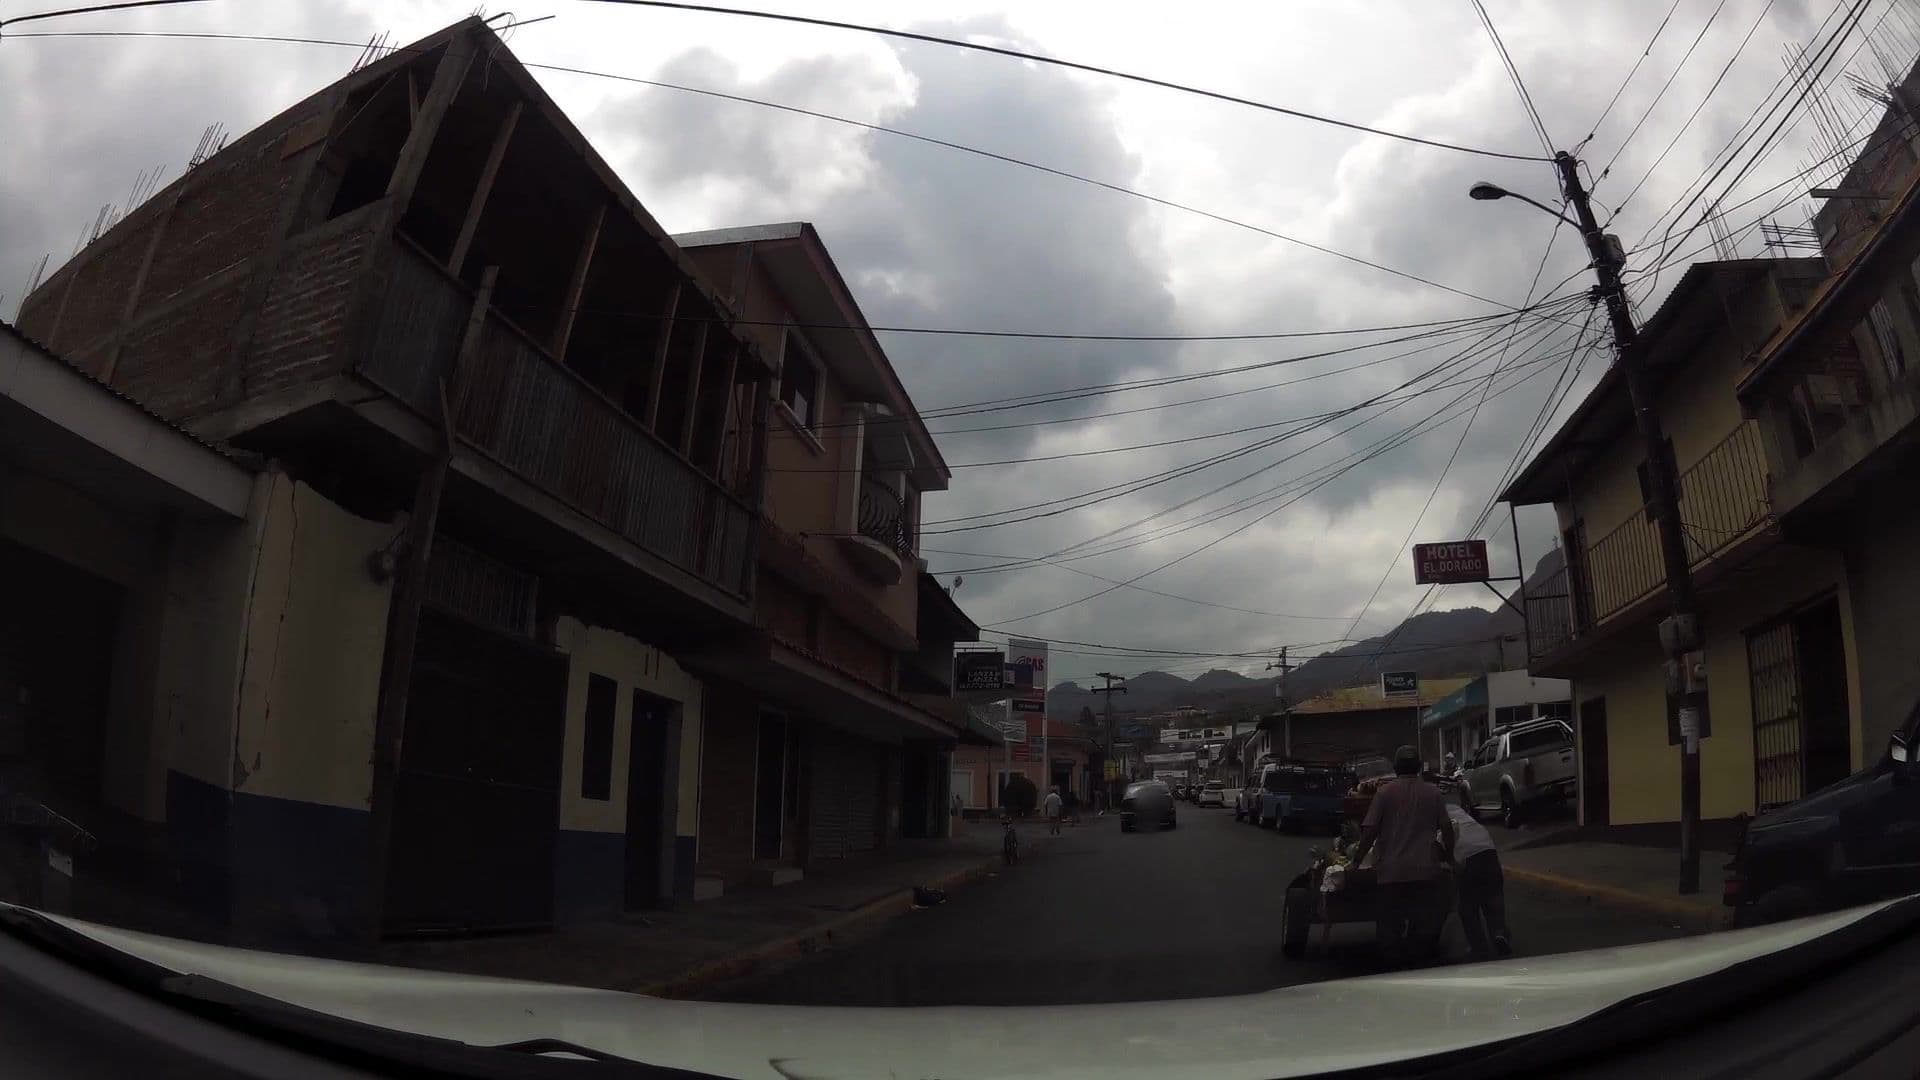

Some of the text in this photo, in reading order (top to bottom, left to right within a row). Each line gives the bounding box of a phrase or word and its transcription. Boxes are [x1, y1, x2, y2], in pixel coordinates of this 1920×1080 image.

[1425, 543, 1475, 560] HOTEL
[1424, 559, 1482, 574] EL DORADO
